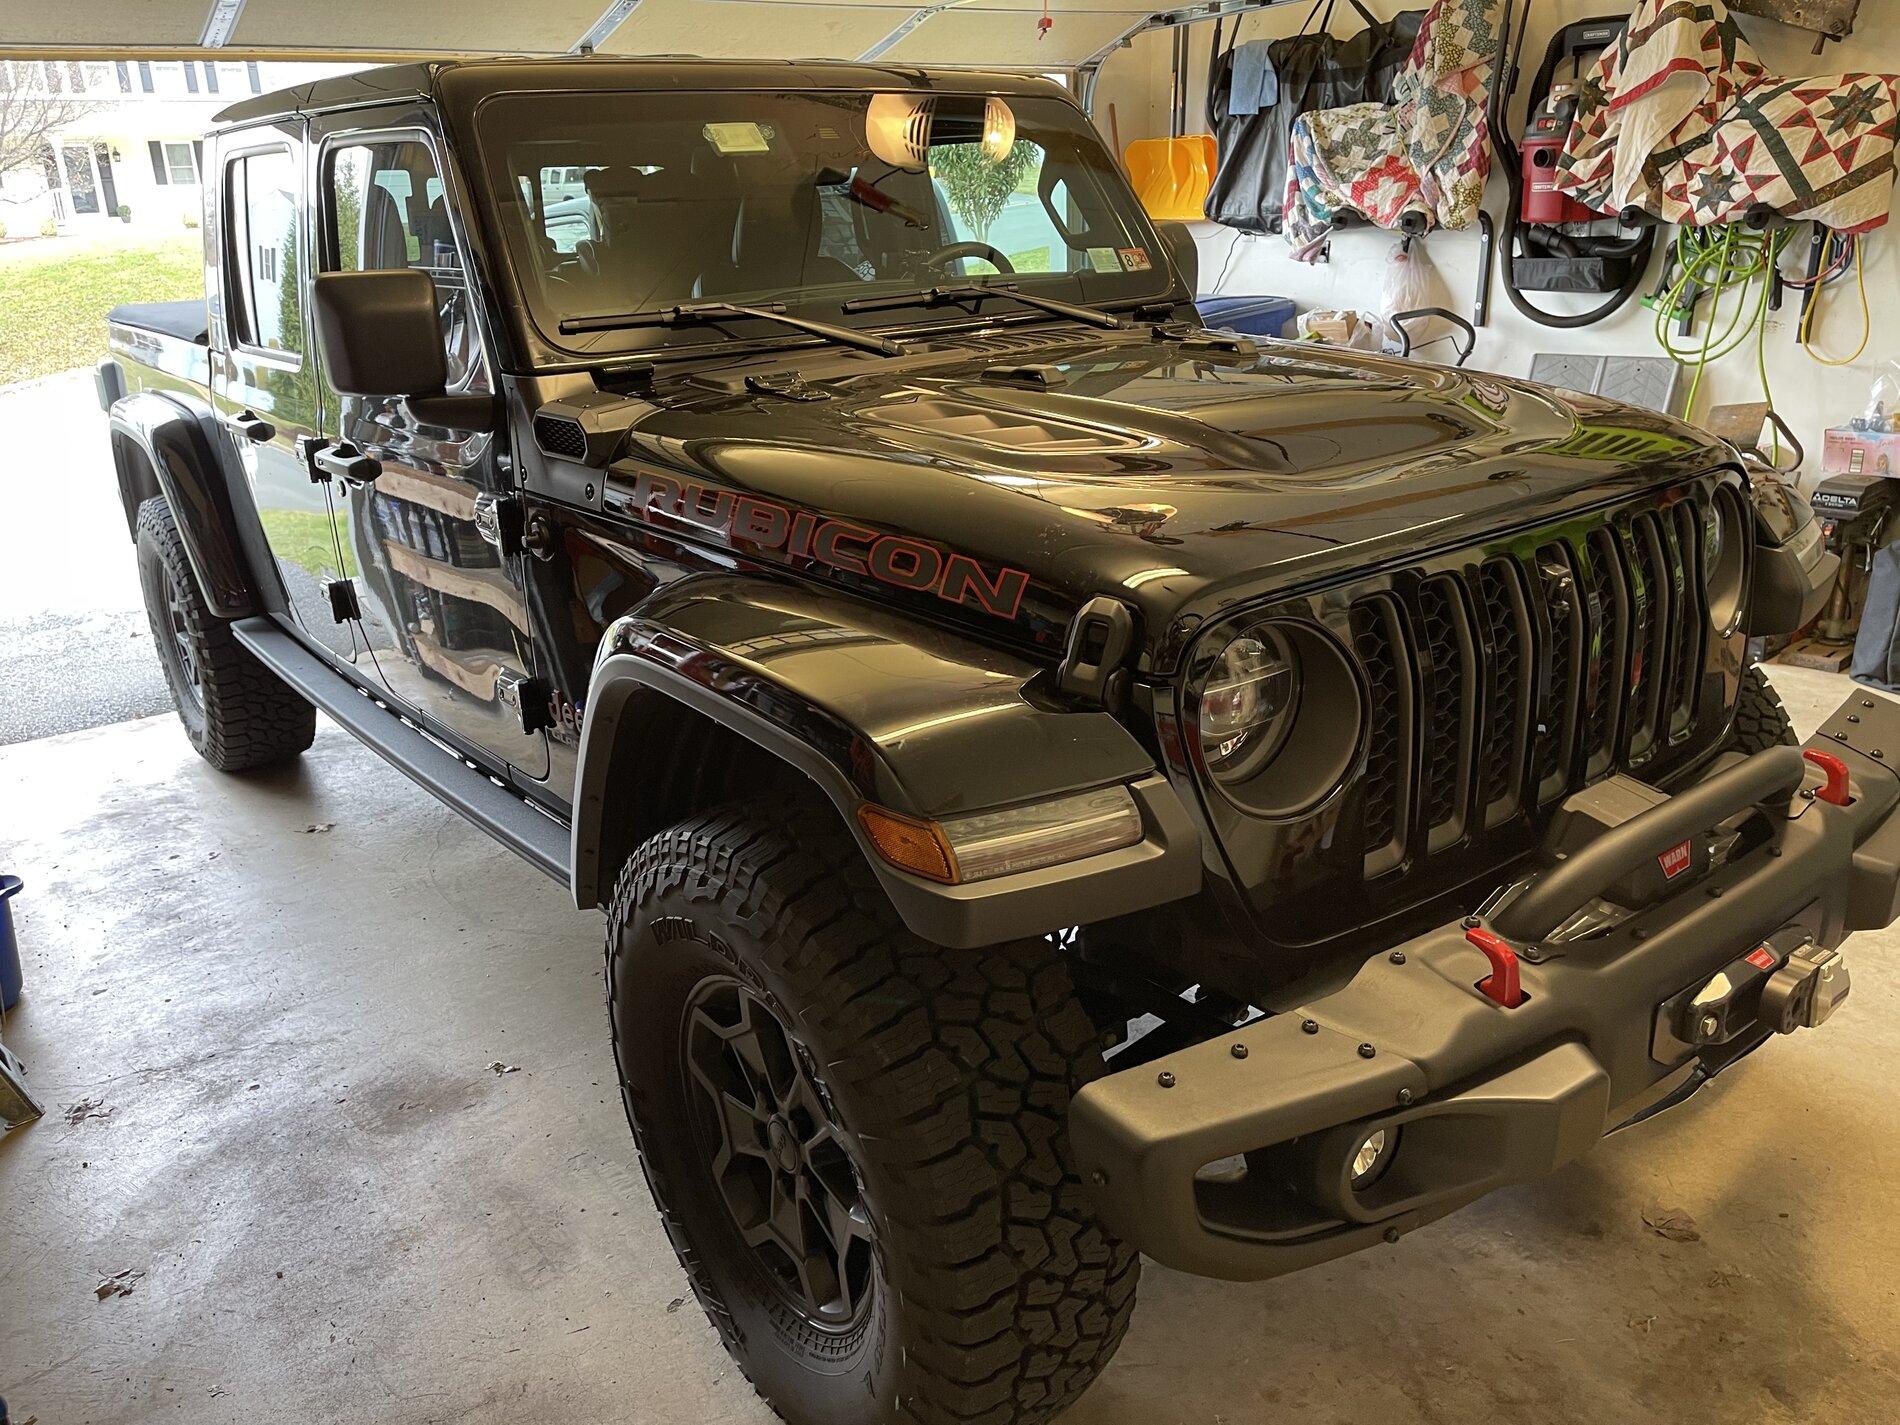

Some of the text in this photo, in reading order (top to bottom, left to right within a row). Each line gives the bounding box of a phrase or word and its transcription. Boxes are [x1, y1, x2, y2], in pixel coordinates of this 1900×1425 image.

[1124, 254, 1134, 267] 8
[1821, 494, 1857, 506] DELTA
[632, 470, 1030, 620] RUBICON
[548, 688, 583, 734] Jee
[1663, 845, 1688, 869] WARN
